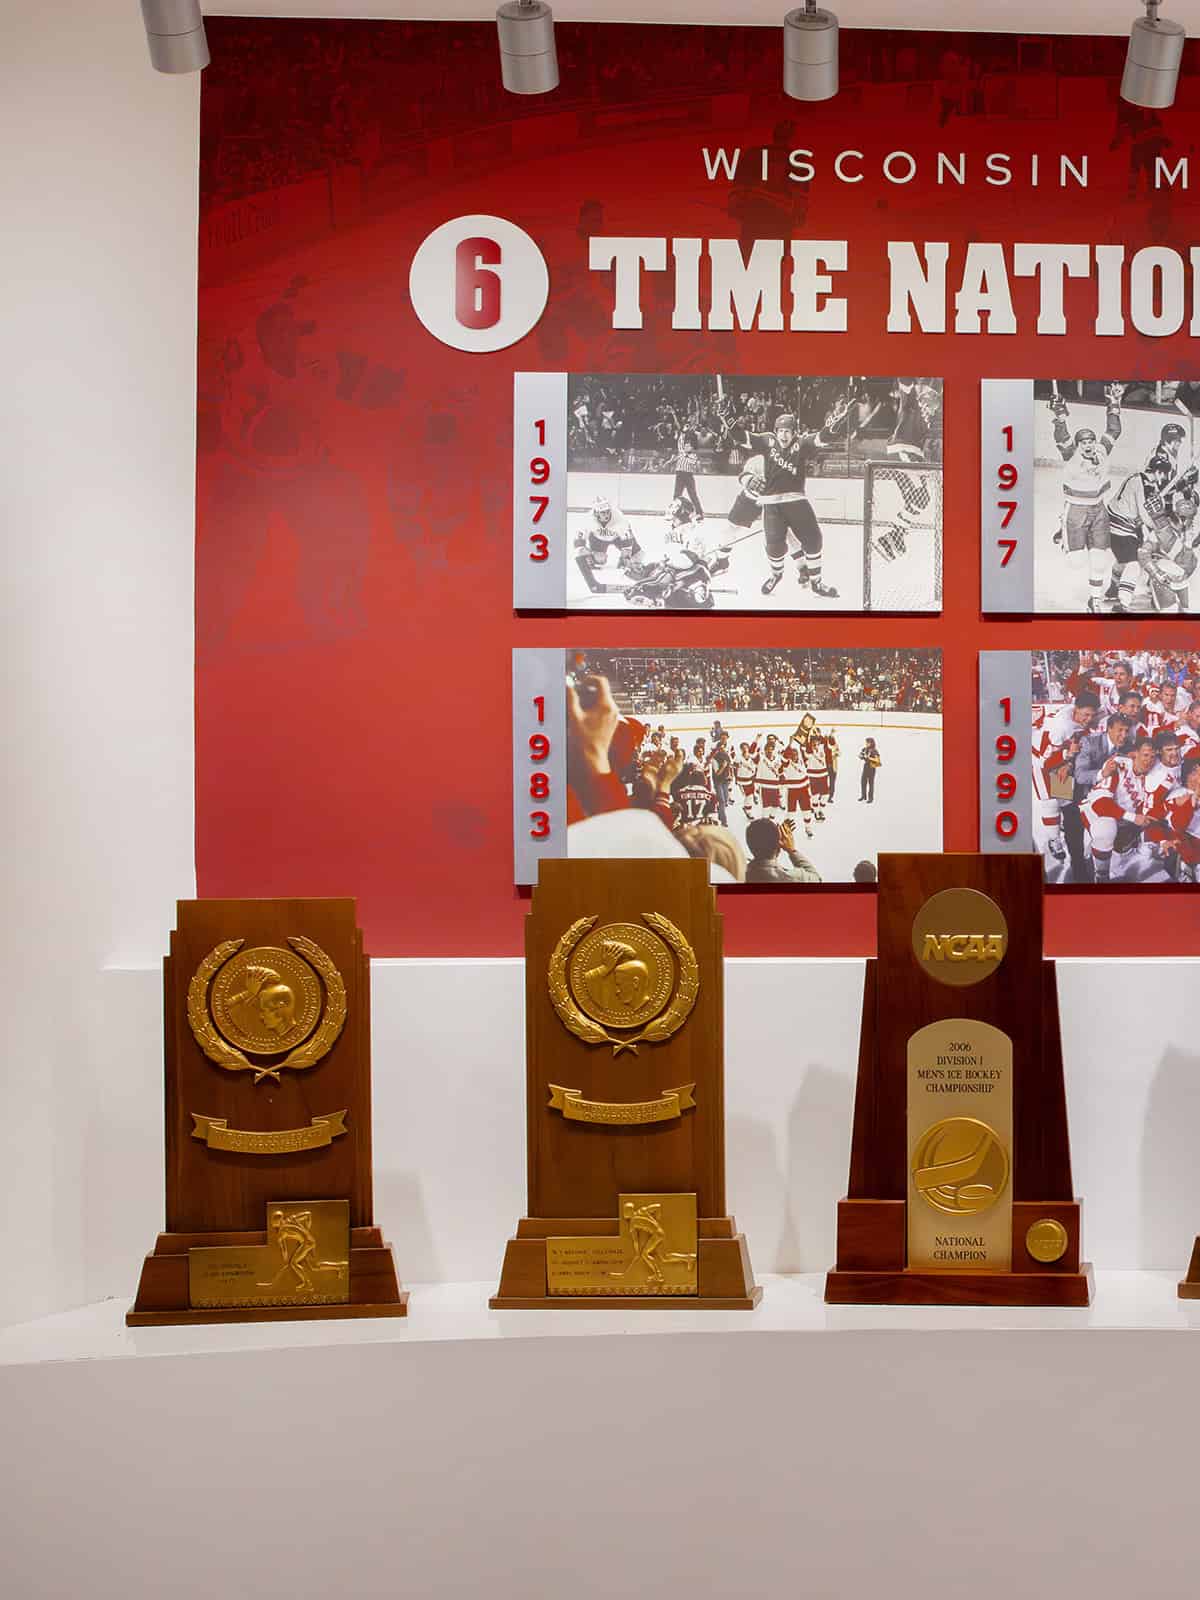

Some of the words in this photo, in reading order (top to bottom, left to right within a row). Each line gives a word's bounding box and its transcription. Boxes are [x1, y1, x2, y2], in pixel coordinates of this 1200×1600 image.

[702, 147, 1088, 187] WISCONSIN
[455, 237, 502, 330] 6
[589, 236, 848, 332] TIME
[529, 419, 550, 562] 1973
[997, 425, 1018, 567] 1977
[529, 696, 550, 838] 1983
[995, 697, 1018, 838] 1990
[686, 799, 706, 818] 17
[922, 933, 1003, 961] NCAA
[948, 1042, 972, 1052] 2006
[936, 1055, 977, 1066] DIVISION
[917, 1069, 945, 1080] MEN'S
[947, 1069, 963, 1080] ICE
[965, 1069, 1003, 1080] HOCKEY
[925, 1082, 995, 1093] CHAMPIONSHIP
[935, 1236, 985, 1247] NATIONAL
[933, 1249, 987, 1261] CHAMPION
